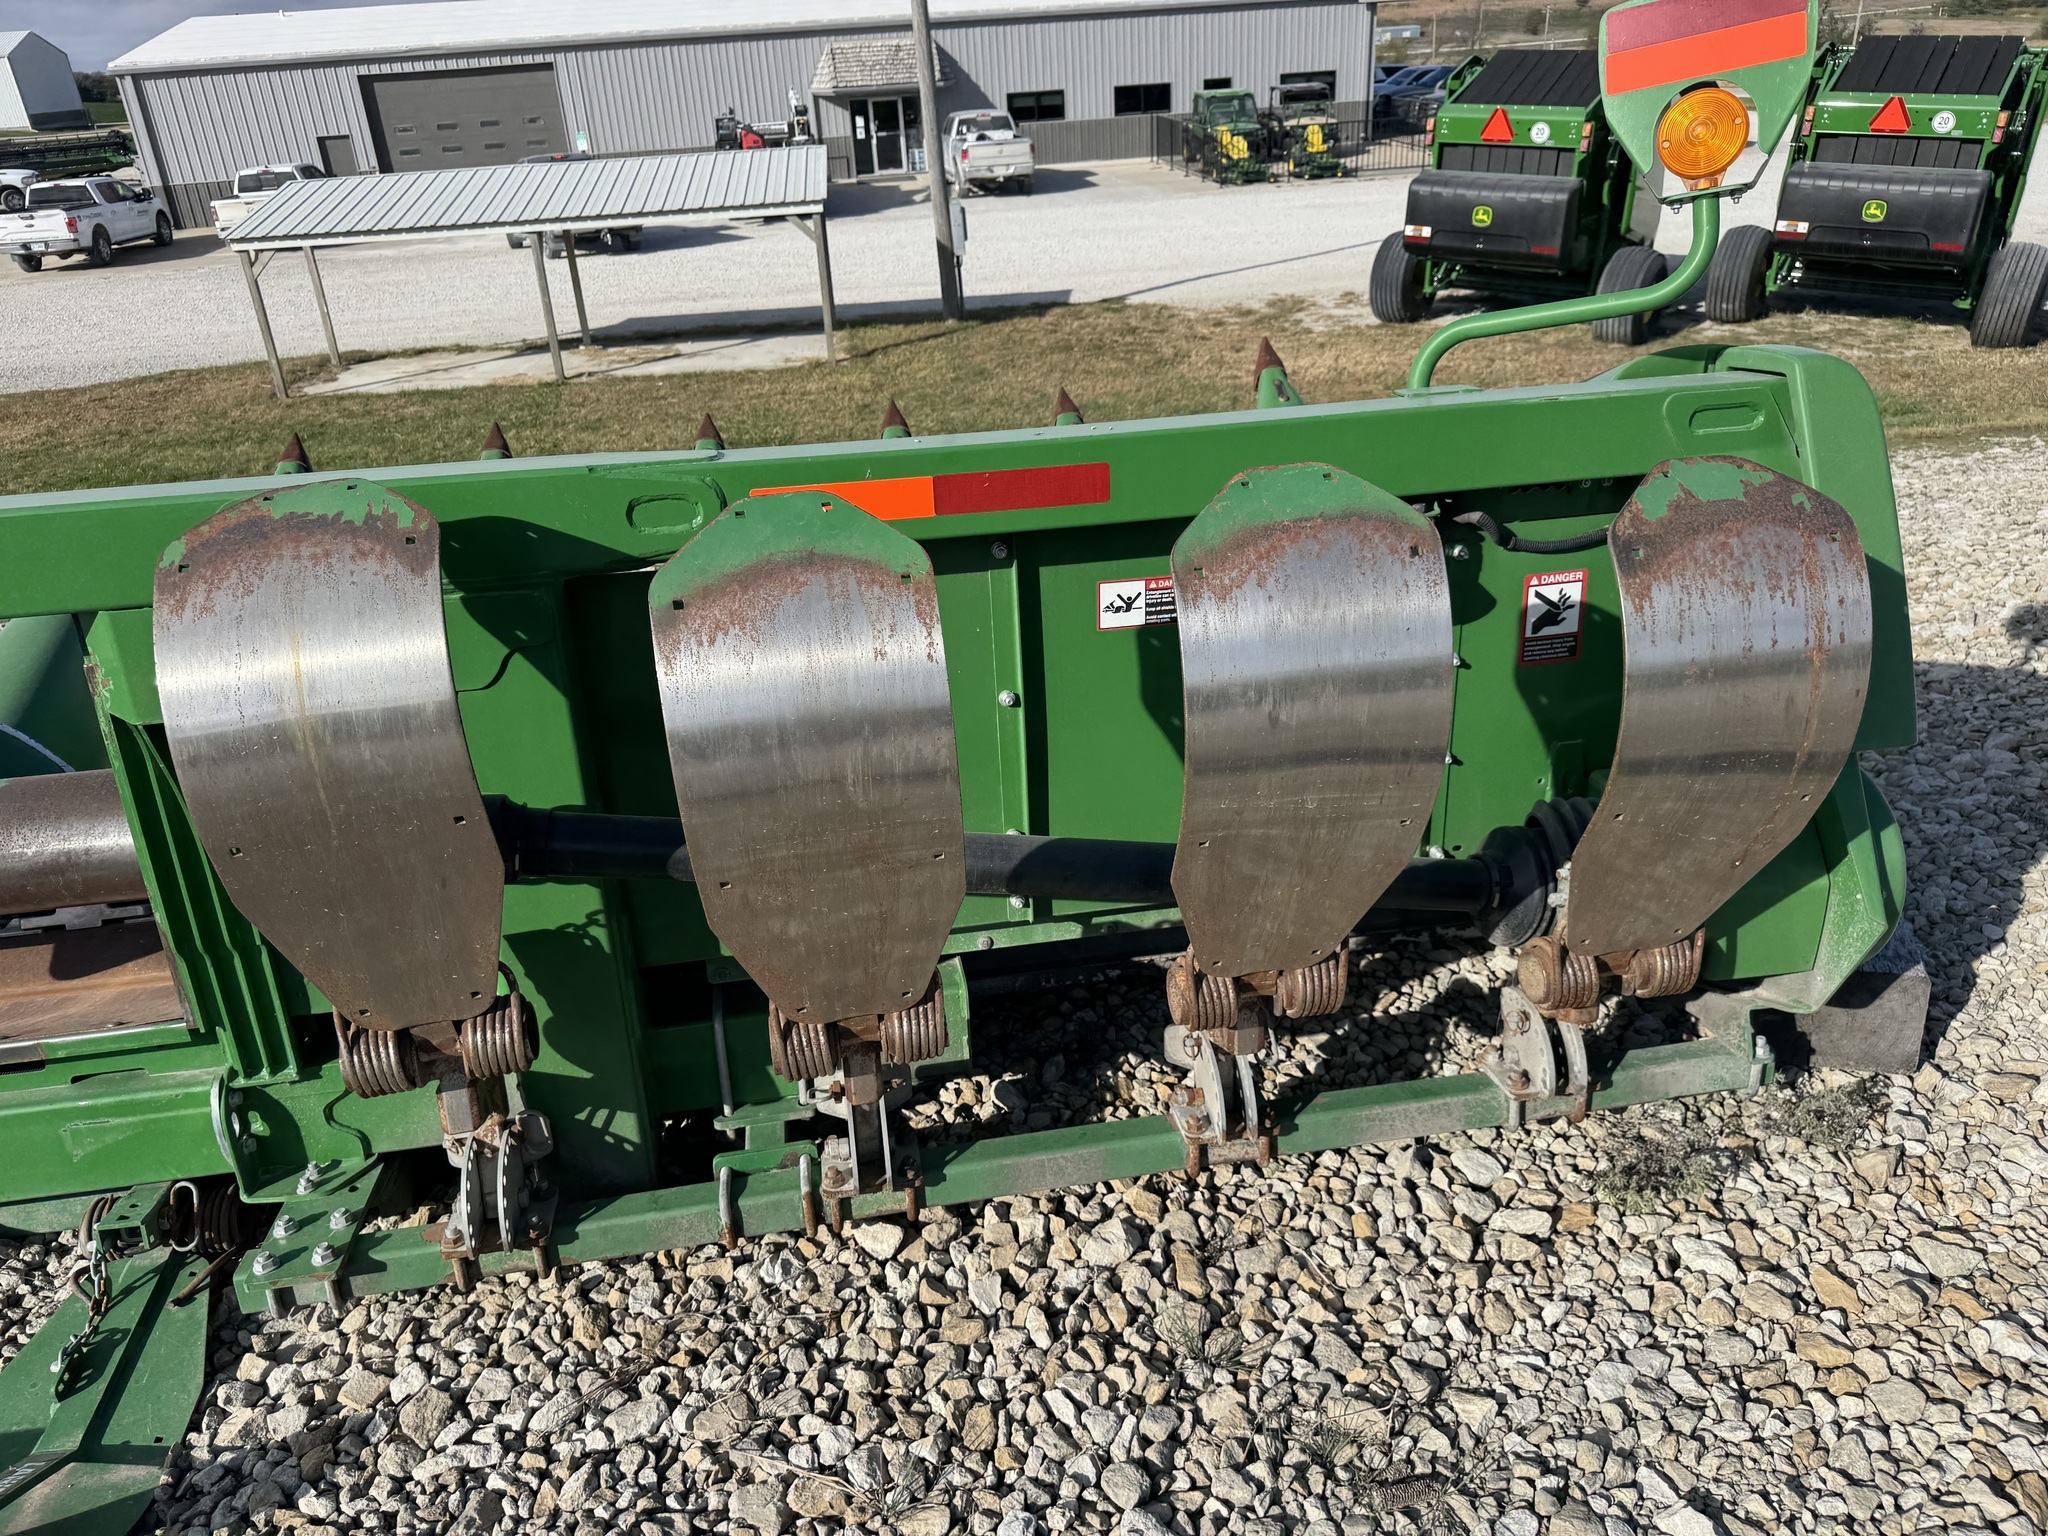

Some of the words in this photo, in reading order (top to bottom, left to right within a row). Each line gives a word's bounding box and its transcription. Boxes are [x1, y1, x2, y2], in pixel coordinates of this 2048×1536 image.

[1938, 116, 1950, 126] 20
[1535, 127, 1545, 136] 20
[1541, 572, 1583, 584] DANGER
